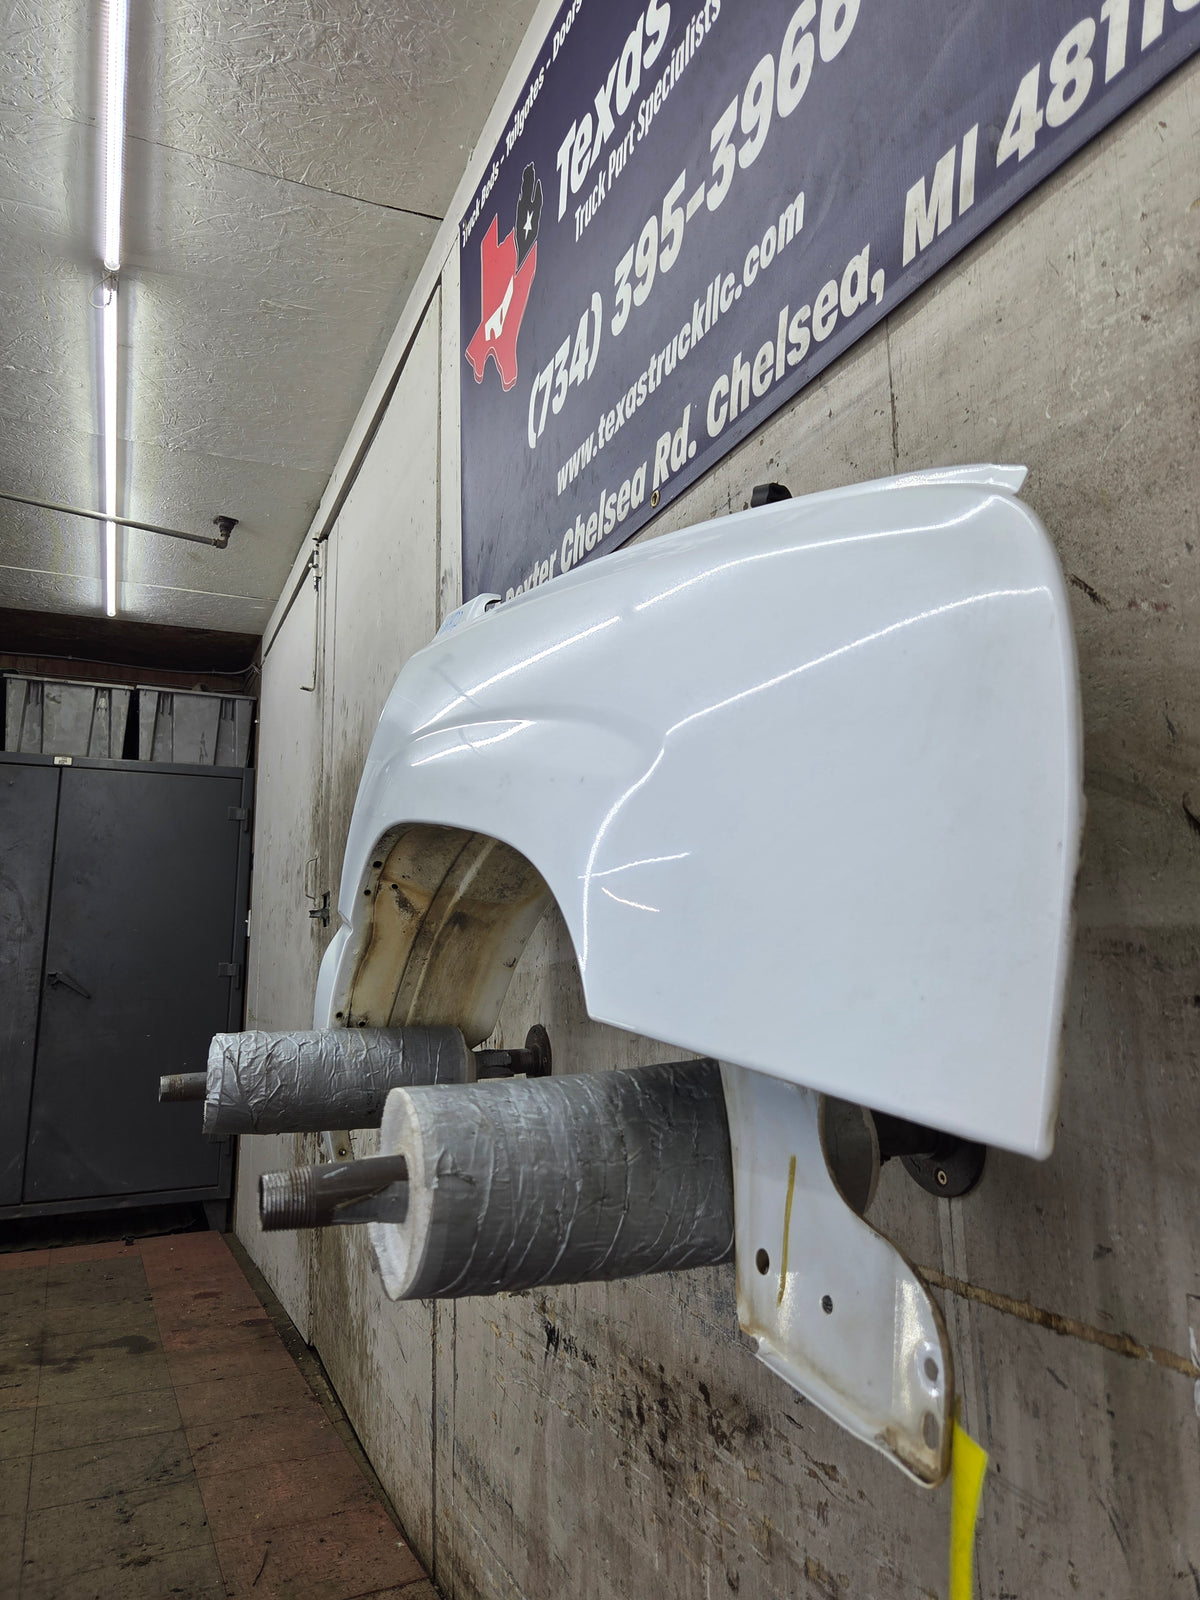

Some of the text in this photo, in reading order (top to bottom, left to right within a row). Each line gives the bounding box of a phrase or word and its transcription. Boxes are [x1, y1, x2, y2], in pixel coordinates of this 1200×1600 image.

[481, 161, 499, 209] Beds
[505, 67, 545, 157] Tailgates
[556, 0, 671, 222] Texas
[574, 0, 721, 242] Truck Part Specialists
[505, 0, 1200, 601] ter Chelsea Rd. Chelsea, MI 481
[527, 292, 603, 449] (734)
[556, 191, 805, 496] www.texastruckllc.com
